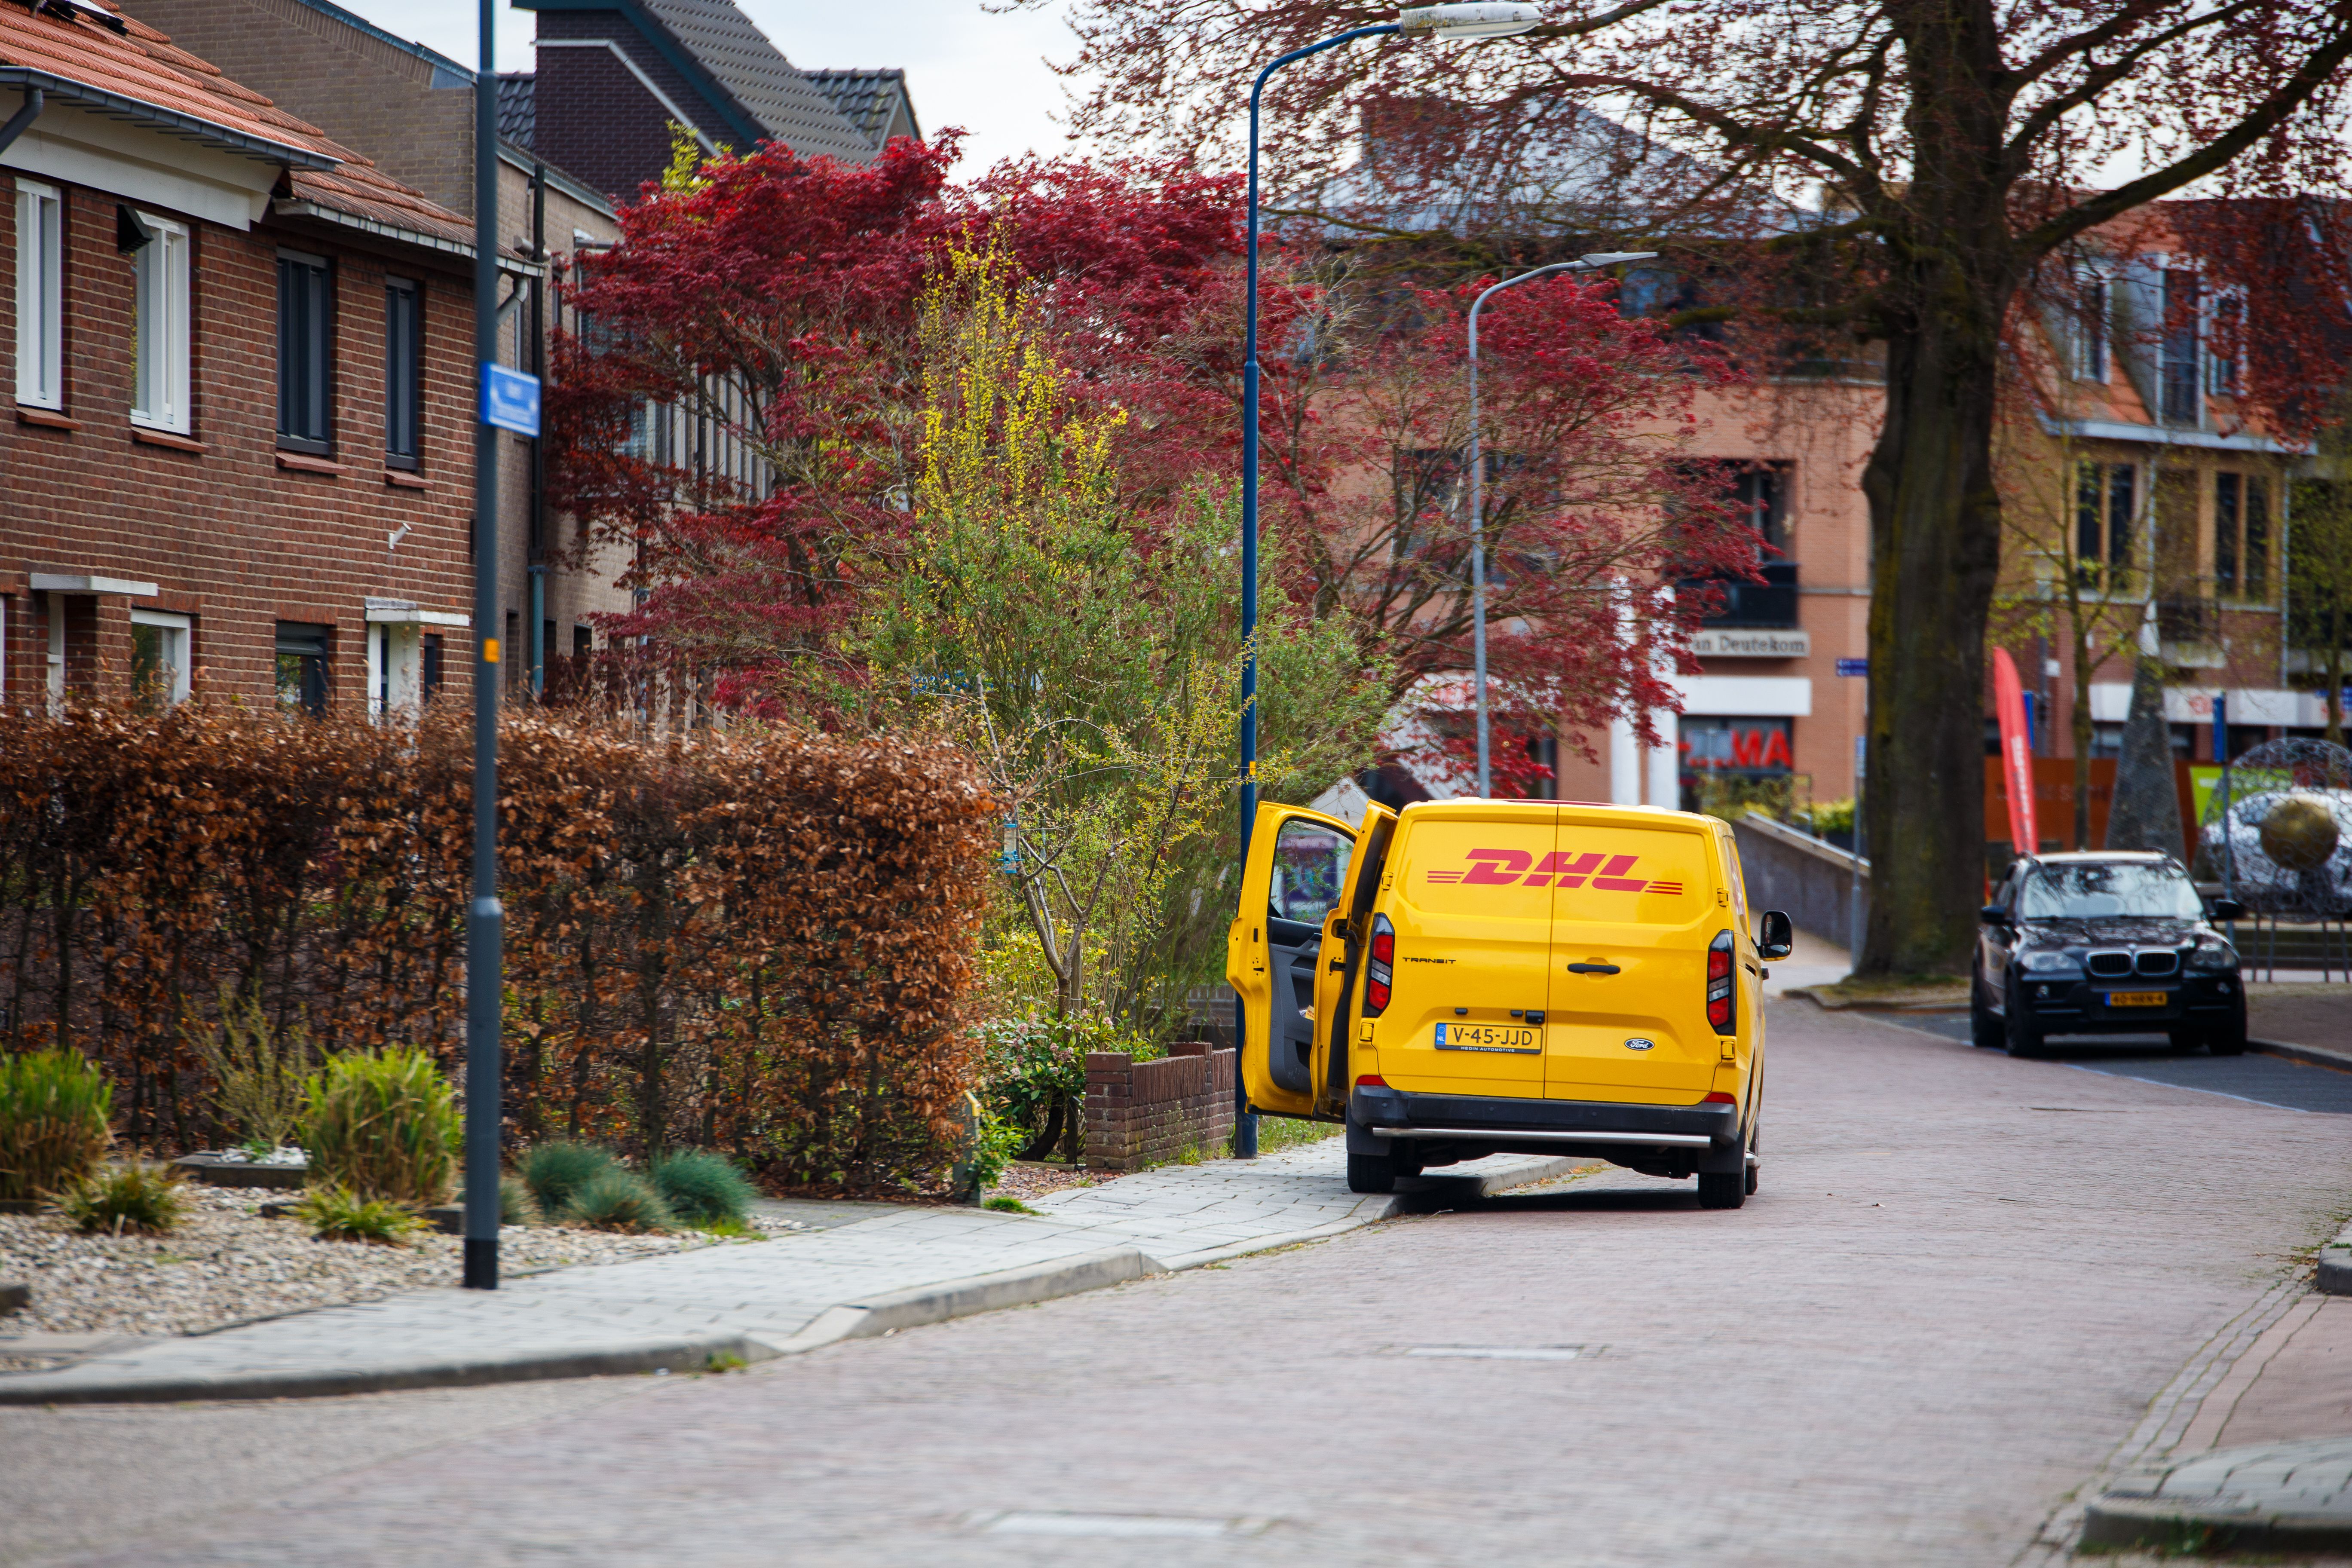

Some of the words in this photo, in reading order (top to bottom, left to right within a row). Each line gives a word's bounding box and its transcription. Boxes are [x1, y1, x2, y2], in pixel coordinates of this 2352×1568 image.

[1461, 848, 1649, 892] DHL
[1453, 1027, 1533, 1046] V-45-JJD
[1630, 1040, 1649, 1048] Ford
